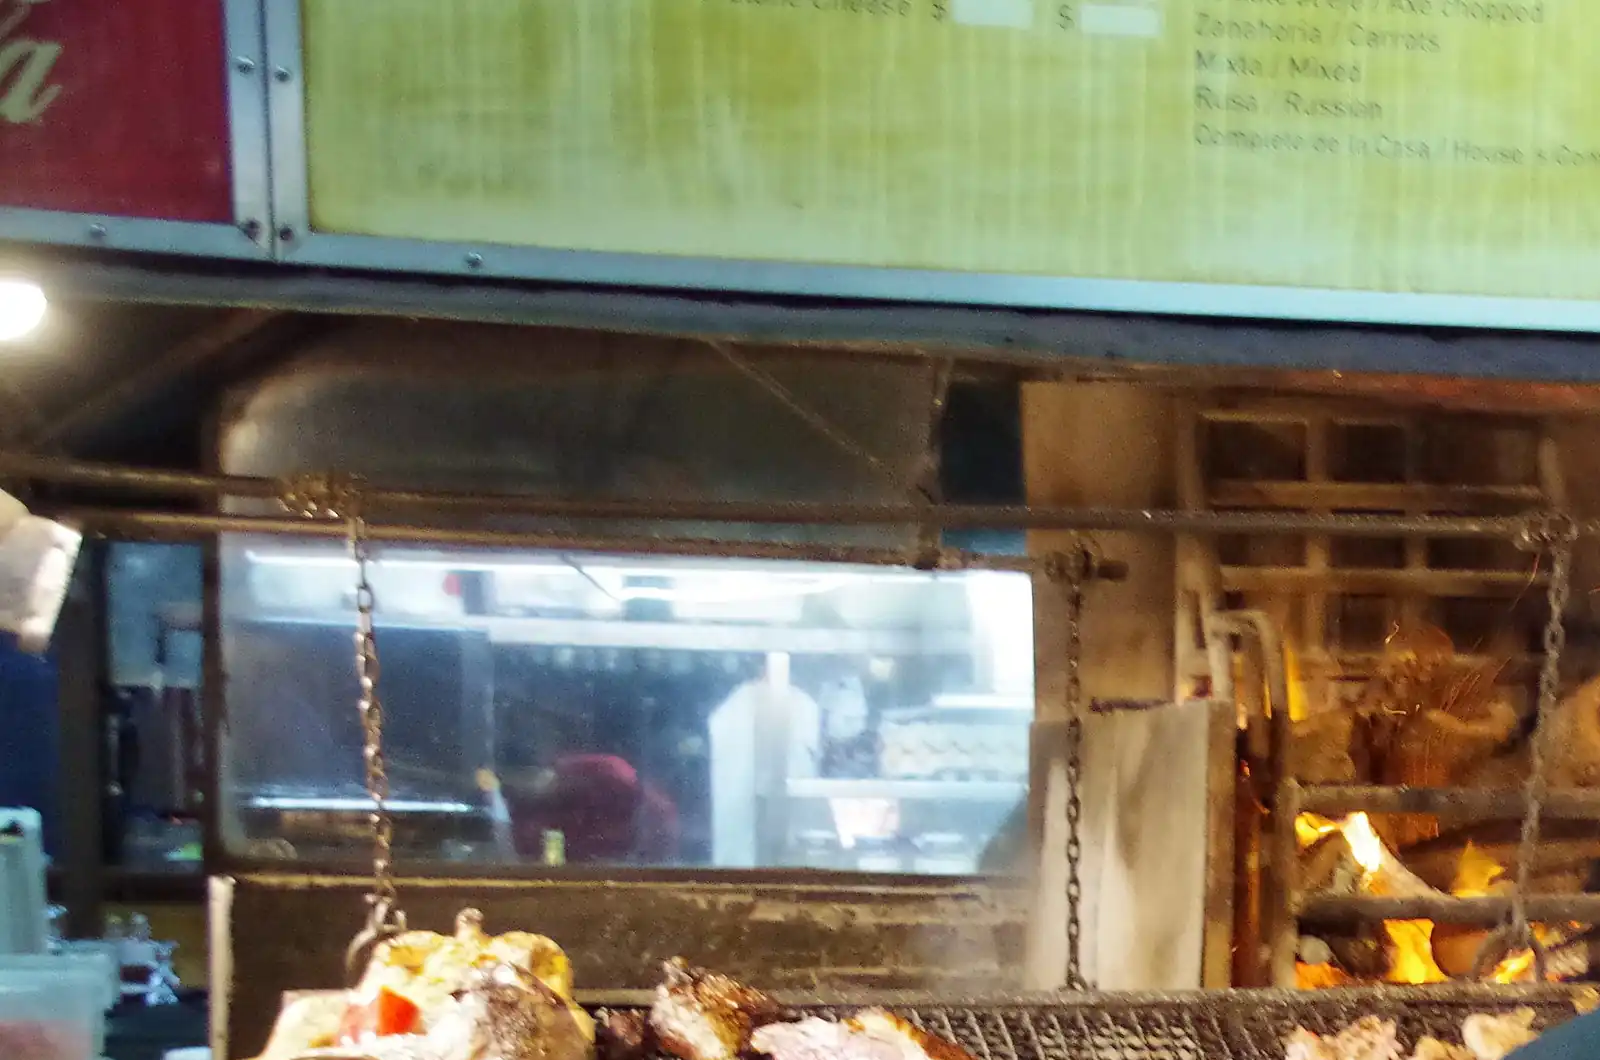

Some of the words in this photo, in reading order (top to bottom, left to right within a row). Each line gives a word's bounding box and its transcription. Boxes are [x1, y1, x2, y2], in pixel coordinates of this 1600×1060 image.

[1056, 3, 1075, 31] $
[1195, 11, 1322, 44] Zanahoria
[1349, 21, 1441, 52] Carrots
[1195, 50, 1263, 77] Mixta
[1288, 56, 1361, 83] Mixed
[1195, 85, 1258, 112] Rusa
[1284, 90, 1382, 120] Russian
